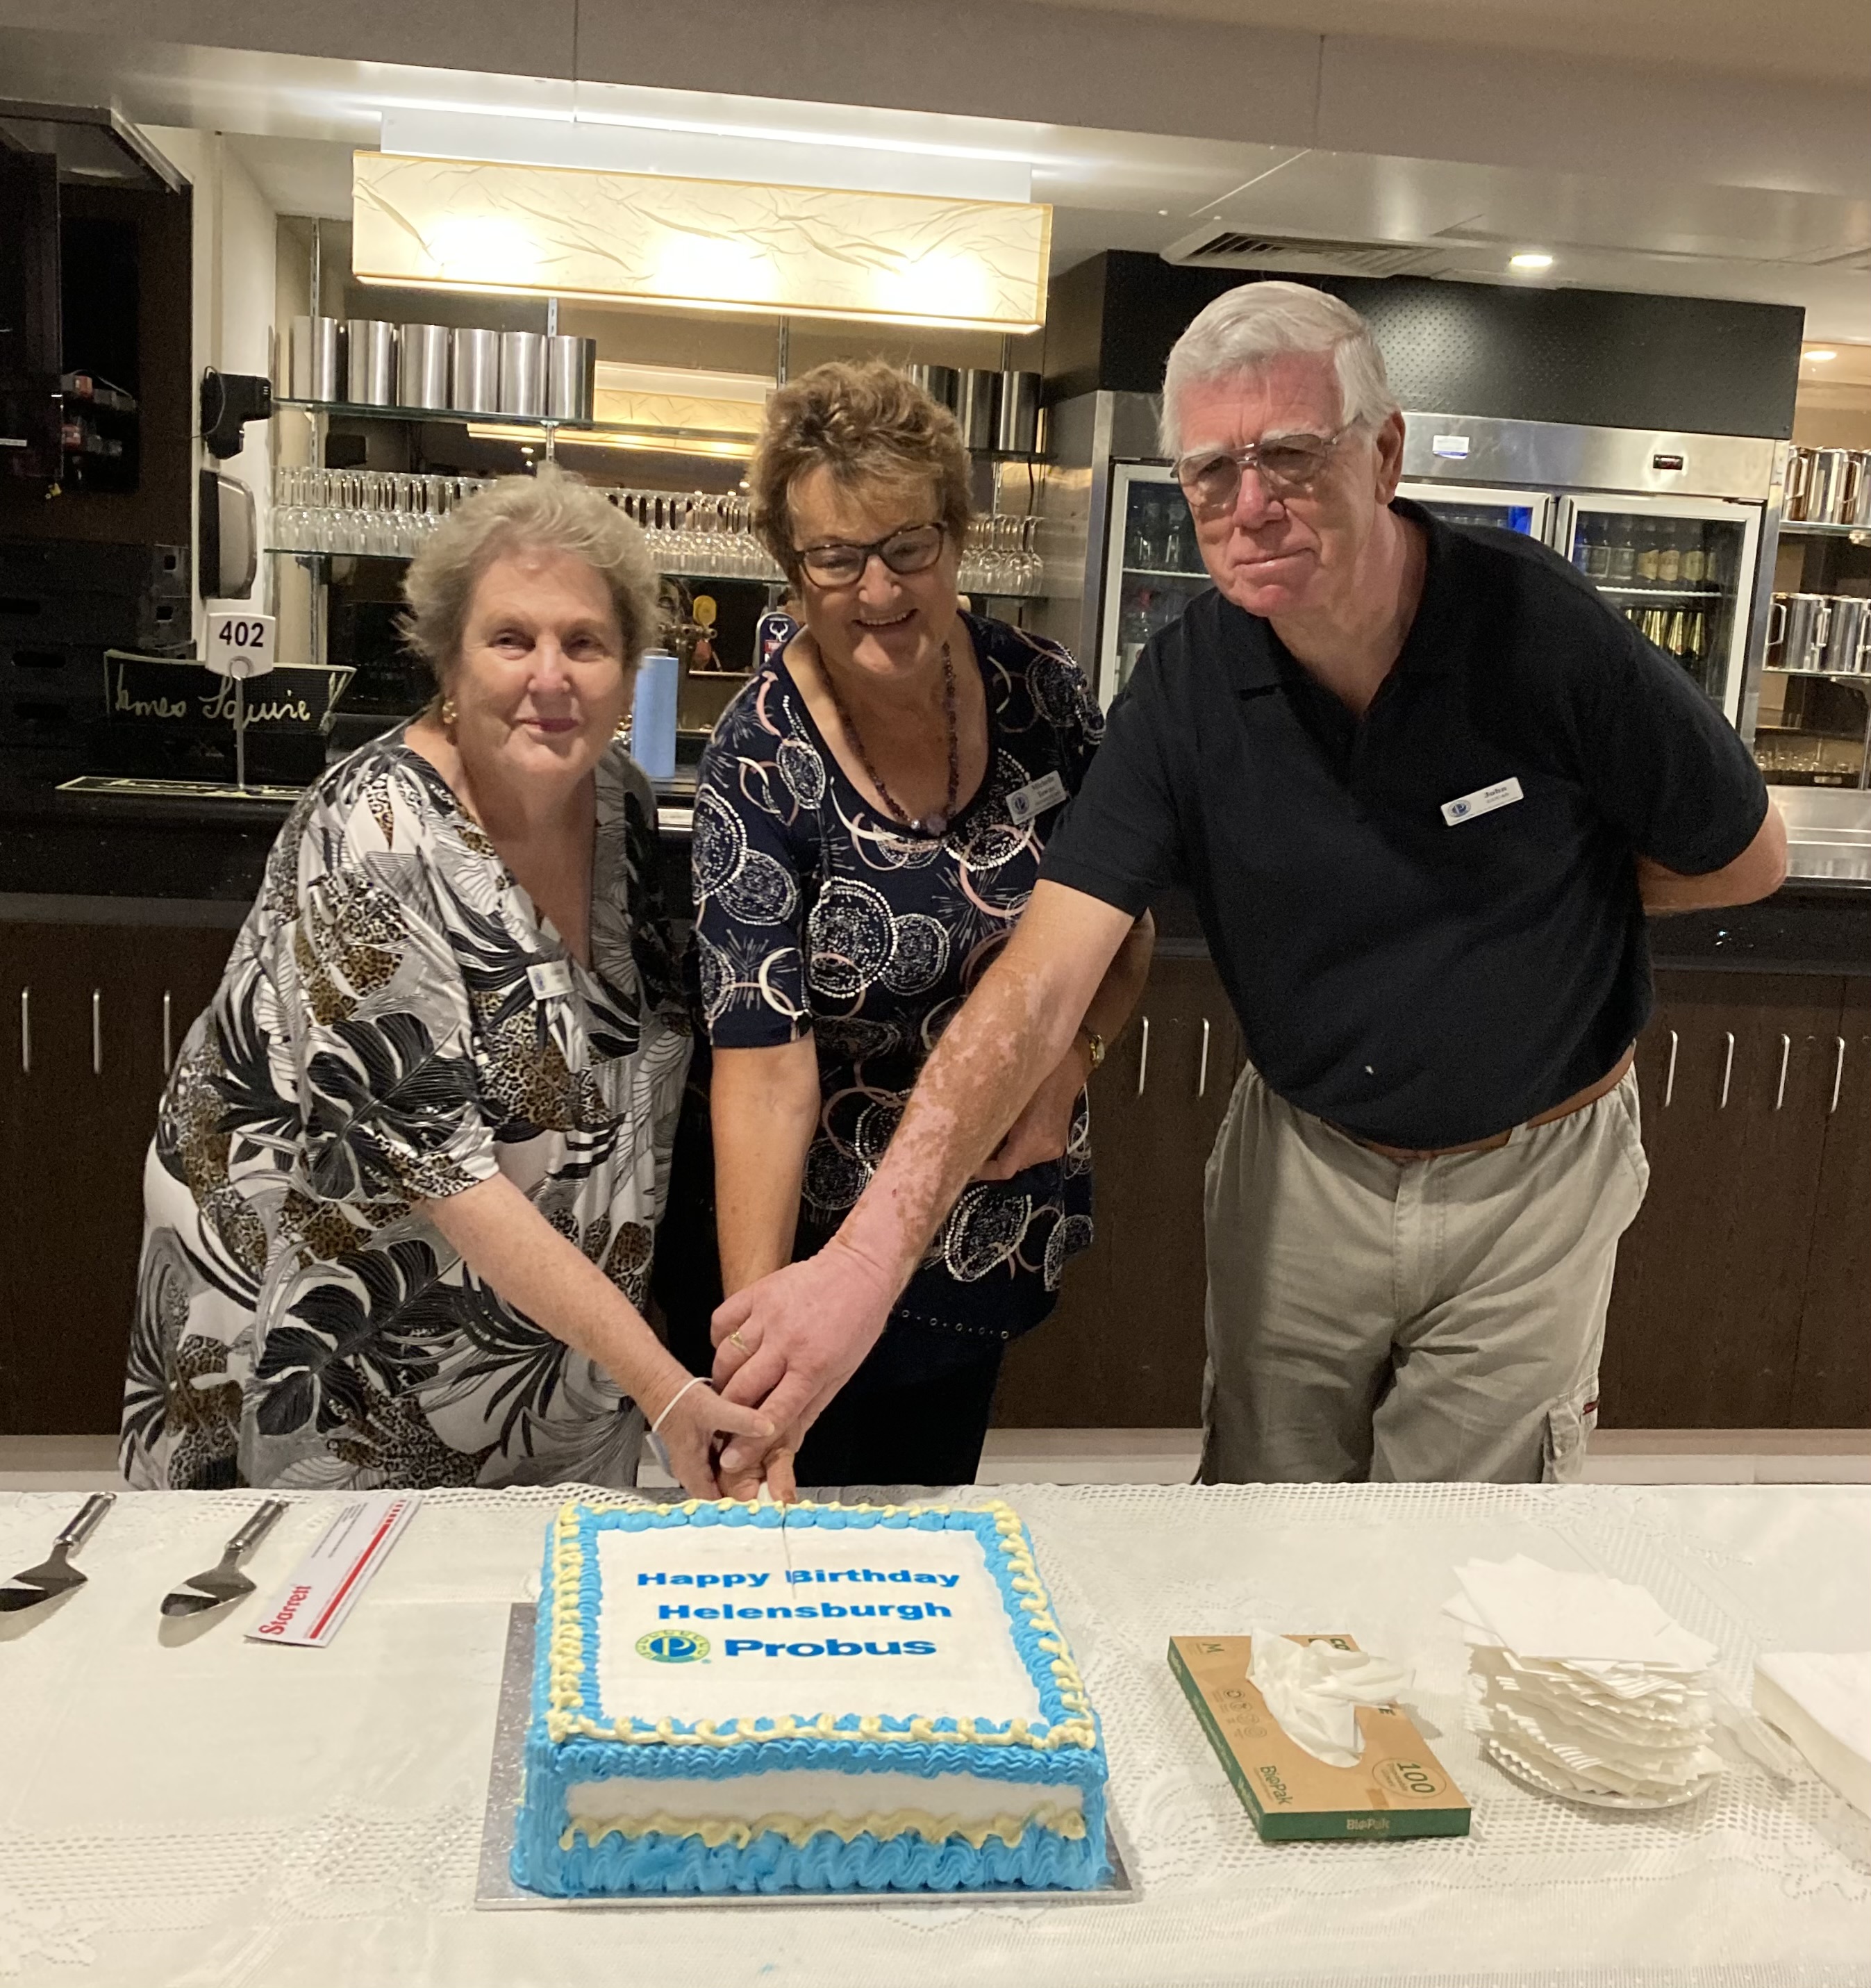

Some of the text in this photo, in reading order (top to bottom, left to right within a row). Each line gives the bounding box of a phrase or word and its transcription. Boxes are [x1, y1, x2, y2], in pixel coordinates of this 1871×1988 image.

[219, 620, 265, 647] 402
[1484, 786, 1508, 798] John
[637, 1569, 960, 1588] Happy Birthday
[258, 1585, 312, 1635] Starrett
[658, 1602, 952, 1621] Helensburgh
[724, 1639, 937, 1657] Probus
[1397, 1762, 1436, 1793] 100
